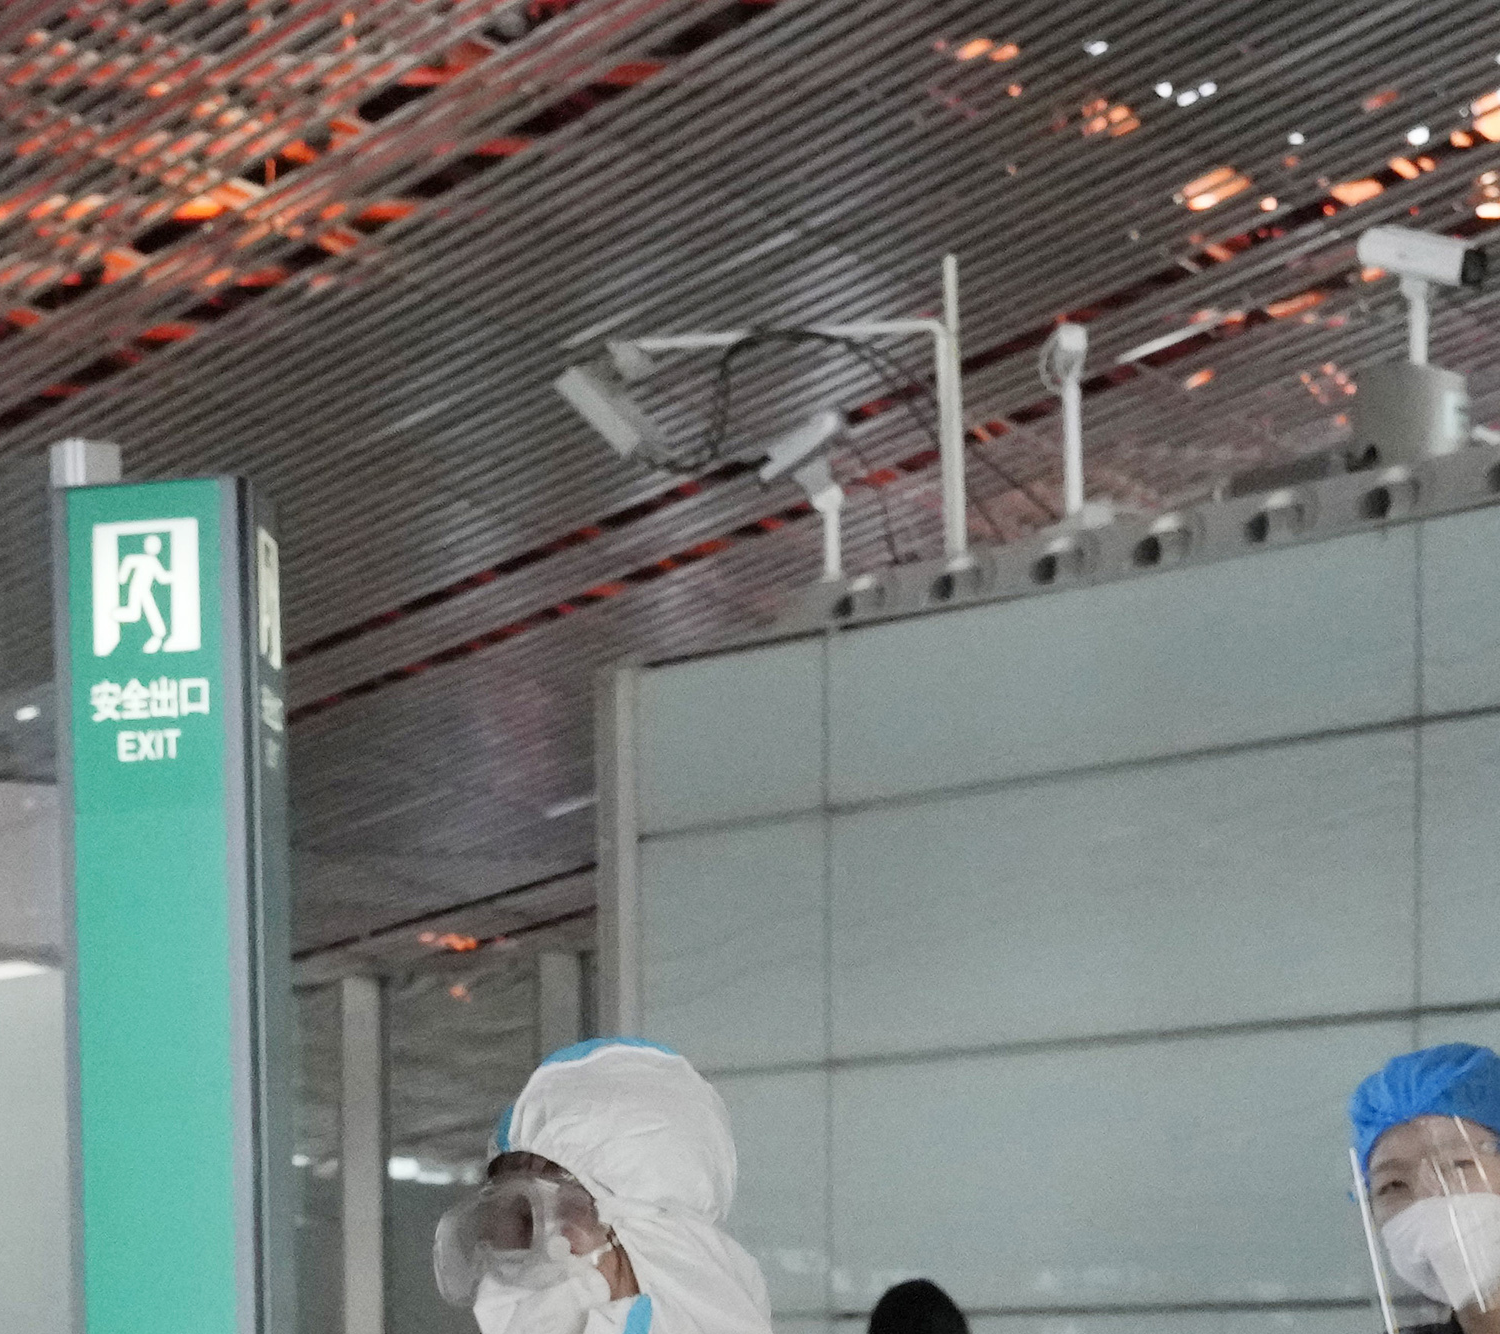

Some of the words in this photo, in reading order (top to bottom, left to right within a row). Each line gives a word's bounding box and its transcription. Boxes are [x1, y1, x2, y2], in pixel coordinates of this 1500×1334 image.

[91, 676, 210, 723] 安全出口
[117, 729, 181, 762] EXIT
